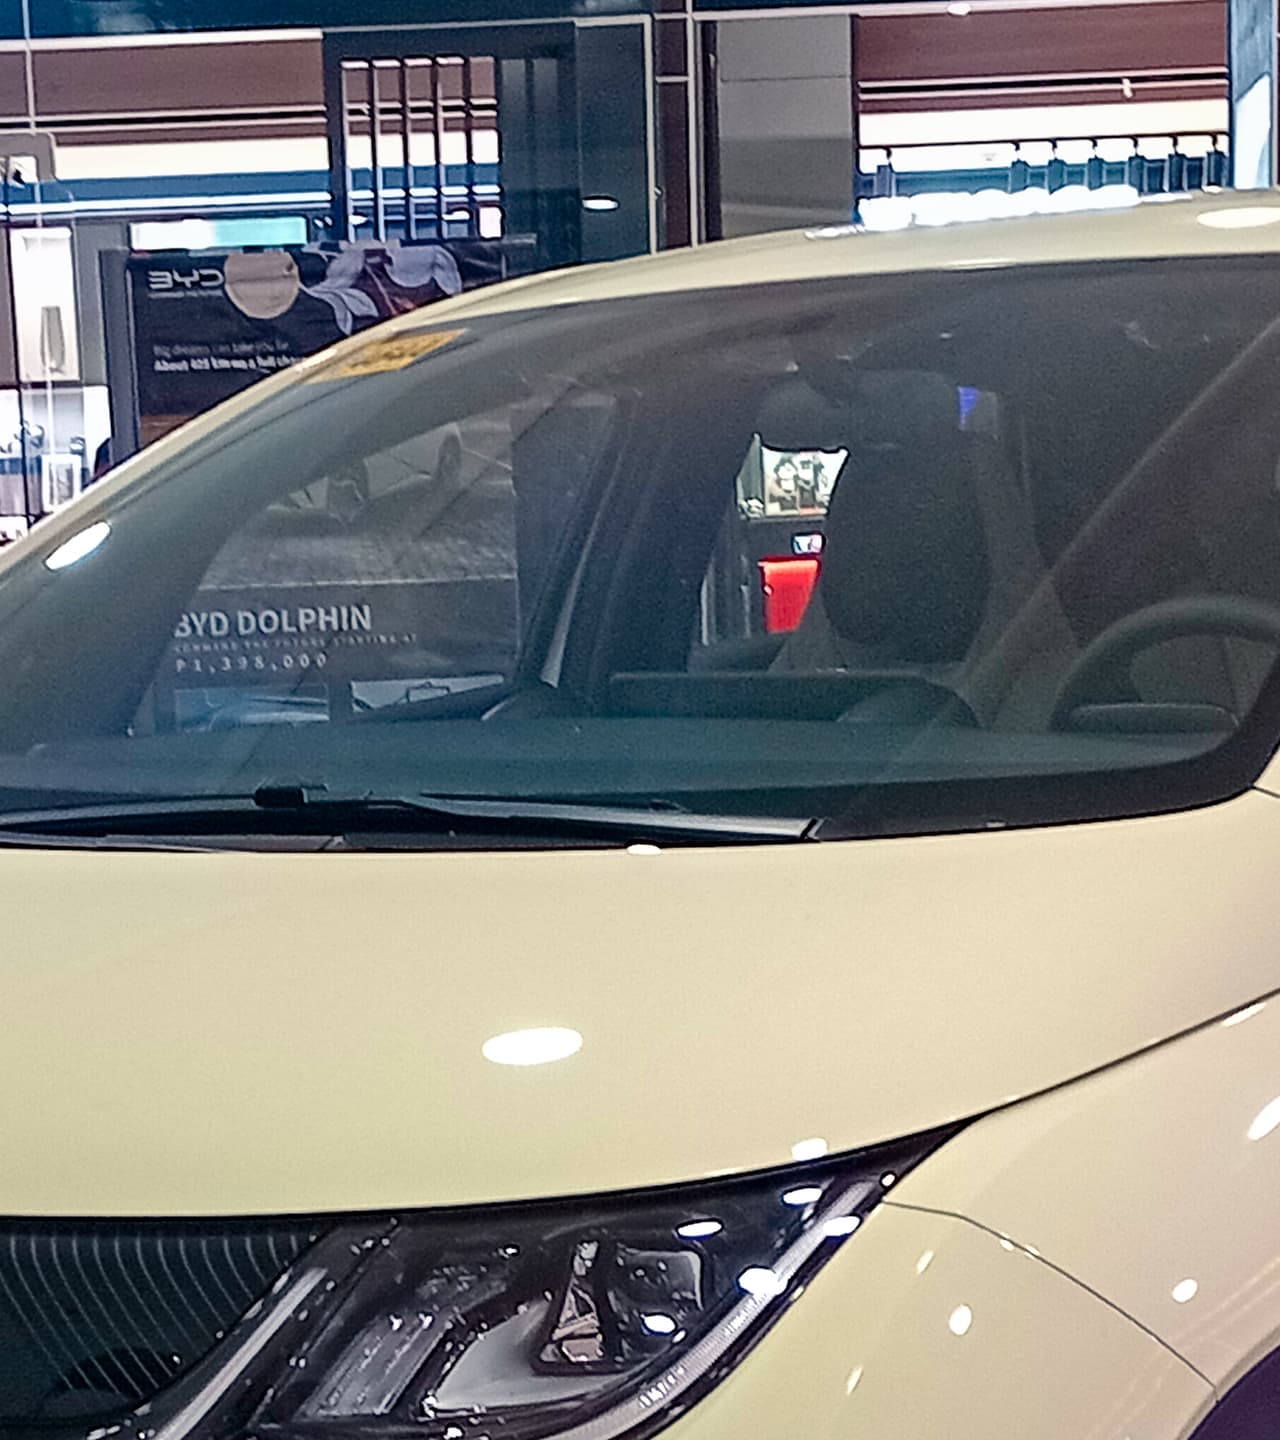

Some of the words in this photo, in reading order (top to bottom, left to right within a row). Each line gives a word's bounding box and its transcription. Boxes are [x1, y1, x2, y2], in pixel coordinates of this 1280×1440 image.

[148, 268, 224, 289] BYD
[174, 612, 230, 638] BYD
[237, 604, 371, 636] DOLPHIN
